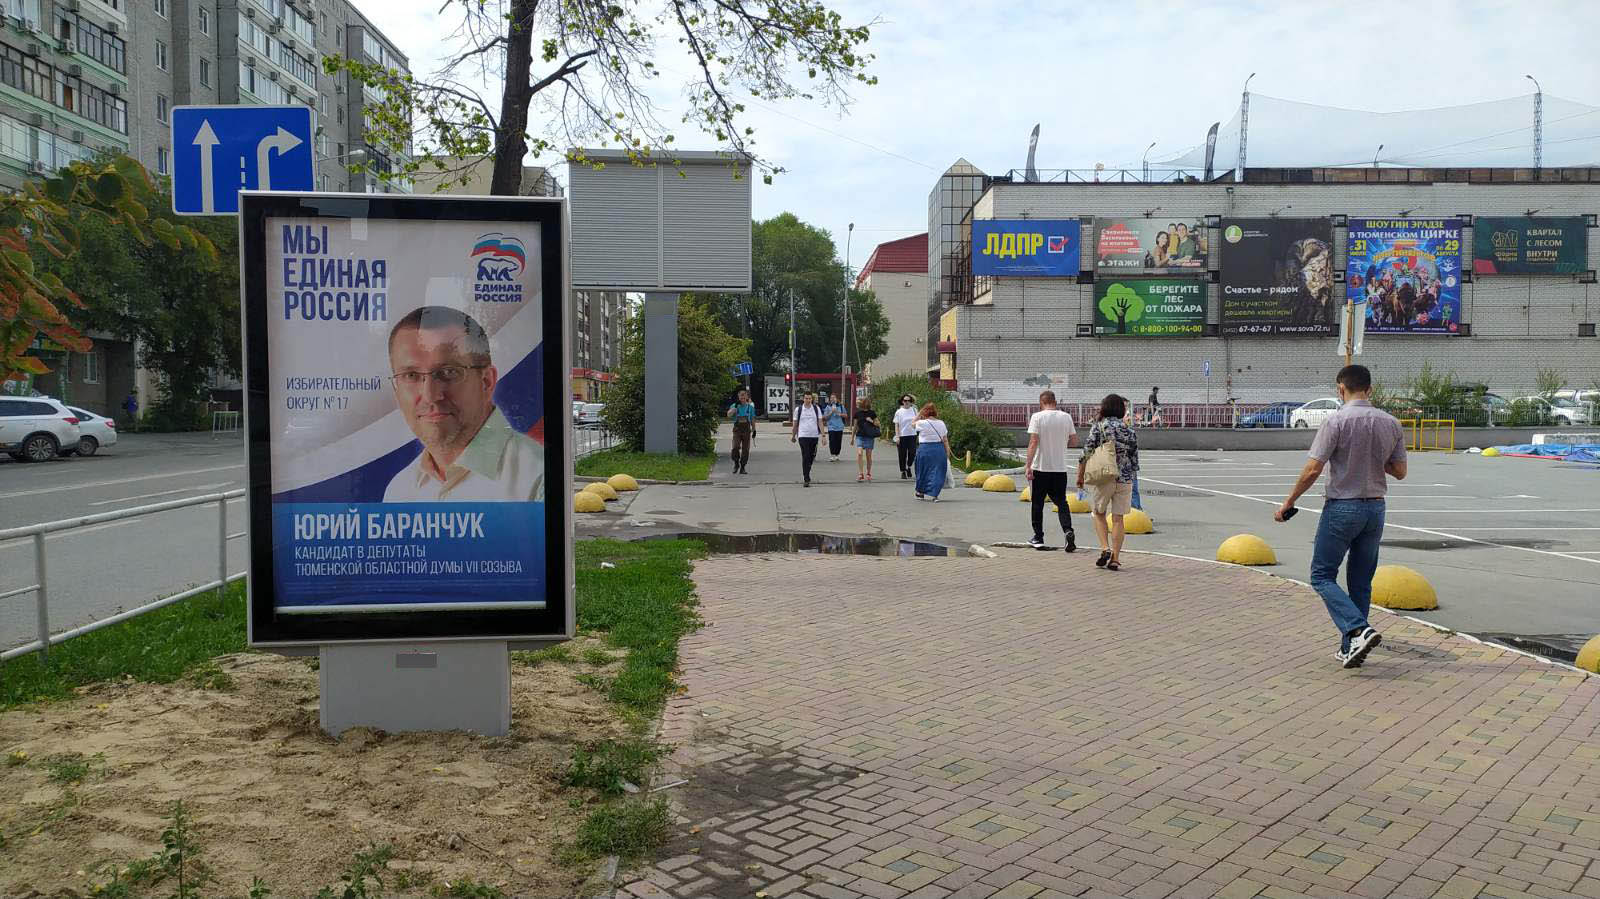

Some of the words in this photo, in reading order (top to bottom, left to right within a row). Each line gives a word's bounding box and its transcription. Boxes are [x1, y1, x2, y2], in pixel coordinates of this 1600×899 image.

[282, 224, 328, 254] МЫ
[1421, 230, 1459, 240] ЦИРКЕ
[982, 233, 1043, 259] ЛДПР
[1354, 240, 1367, 250] 31
[1445, 240, 1459, 251] 29
[283, 258, 386, 290] ЕДИНАЯ
[474, 284, 522, 293] ЕДИНАЯ
[1224, 286, 1262, 294] Счастье
[1270, 286, 1299, 295] рядом
[474, 294, 522, 302] РОССИЯ
[284, 291, 387, 321] РОССИЯ
[286, 376, 381, 390] ИЗБИРАТЕЛЬНЫЙ
[287, 396, 320, 410] ОКРУГ
[294, 508, 360, 540] ЮРИЙ
[368, 512, 484, 539] БАРАНЧУК
[295, 545, 354, 560] КАНДИДАТ
[358, 546, 364, 558] В
[367, 544, 426, 559] ДЕПУТАТЫ
[295, 560, 362, 576] ТЮМЕНСКОЙ
[365, 559, 427, 574] ОБЛАСТНОЙ
[430, 560, 463, 575] ДУМЫ
[465, 560, 478, 573] VII
[481, 560, 522, 573] СОЗЫВА
